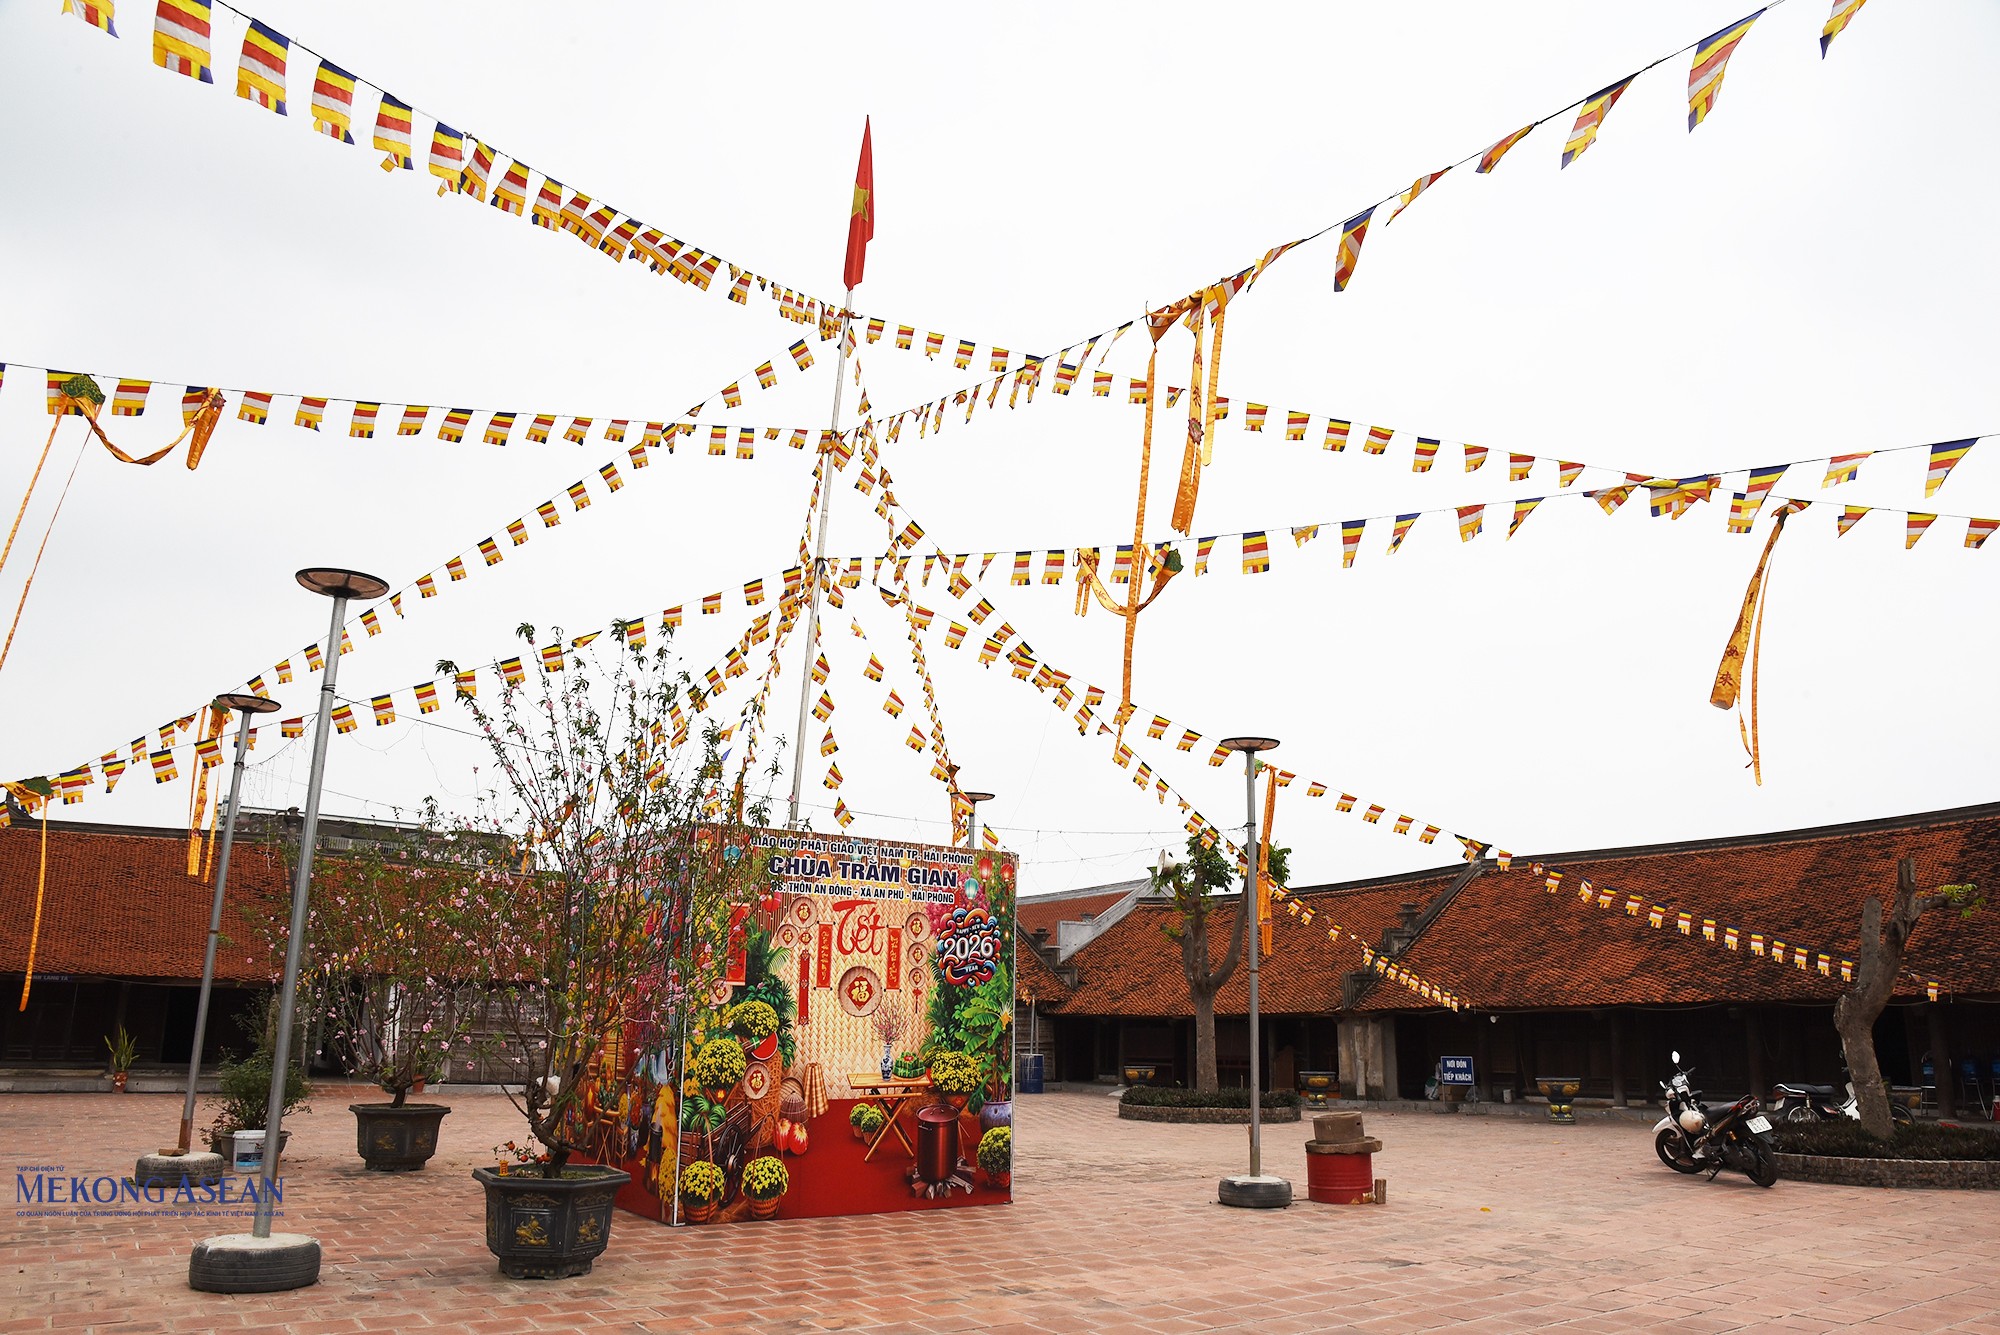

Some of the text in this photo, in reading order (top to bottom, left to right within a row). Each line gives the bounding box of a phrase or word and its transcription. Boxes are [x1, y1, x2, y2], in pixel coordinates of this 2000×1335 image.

[801, 839, 827, 854] PHẬT
[830, 840, 853, 854] GIÁO
[855, 843, 878, 858] VIỆT
[881, 847, 903, 858] NAM
[906, 849, 921, 860] TP.
[924, 848, 939, 862] HẢI
[942, 851, 973, 865] PHÒNG
[769, 855, 957, 888] CHÙA TRĂM GIAN
[789, 880, 811, 893] THÔN
[814, 883, 827, 895] AN
[829, 883, 852, 896] ĐÔNG
[860, 885, 872, 898] XÃ
[874, 888, 885, 899] AN
[888, 887, 904, 900] PHÚ
[912, 886, 925, 901] HẢI
[928, 890, 954, 903] PHÒNG
[832, 899, 886, 956] Tết
[943, 934, 993, 963] 2026
[851, 980, 870, 1002] 福
[1446, 1059, 1467, 1068] NƠI ĐÓN
[1443, 1071, 1471, 1081] TIẾP KHÁCH
